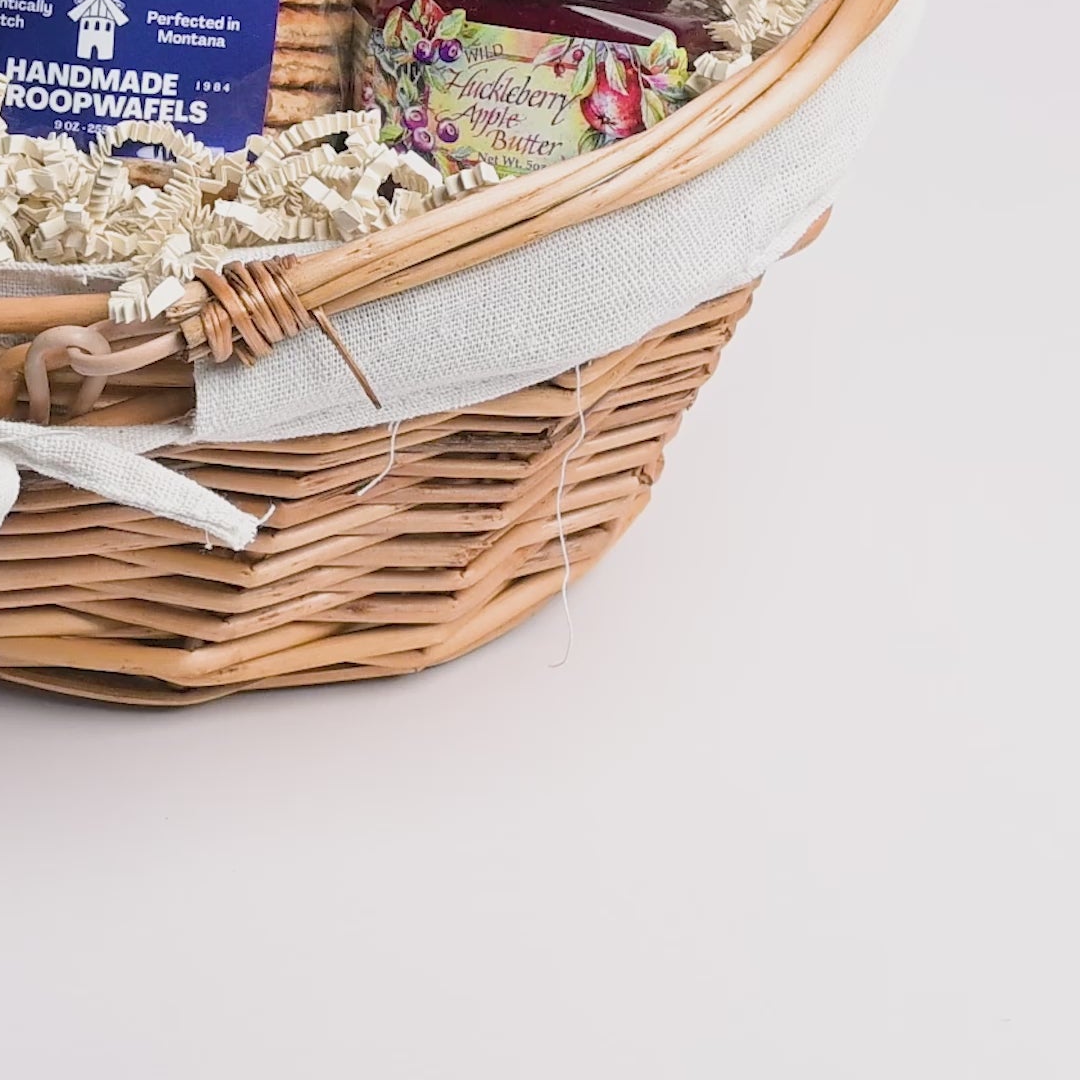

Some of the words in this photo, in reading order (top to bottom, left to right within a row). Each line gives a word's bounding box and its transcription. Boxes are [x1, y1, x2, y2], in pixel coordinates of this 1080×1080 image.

[146, 10, 225, 32] Perfected
[226, 16, 241, 32] in
[157, 29, 226, 49] Montana
[463, 43, 504, 63] WILD
[6, 57, 179, 97] HANDMADE
[195, 80, 231, 93] 1984
[445, 68, 577, 125] Huckleberry
[53, 119, 63, 130] 9
[64, 121, 80, 132] OZ
[442, 102, 522, 137] Apple
[486, 129, 563, 156] Butter
[478, 151, 499, 166] Net
